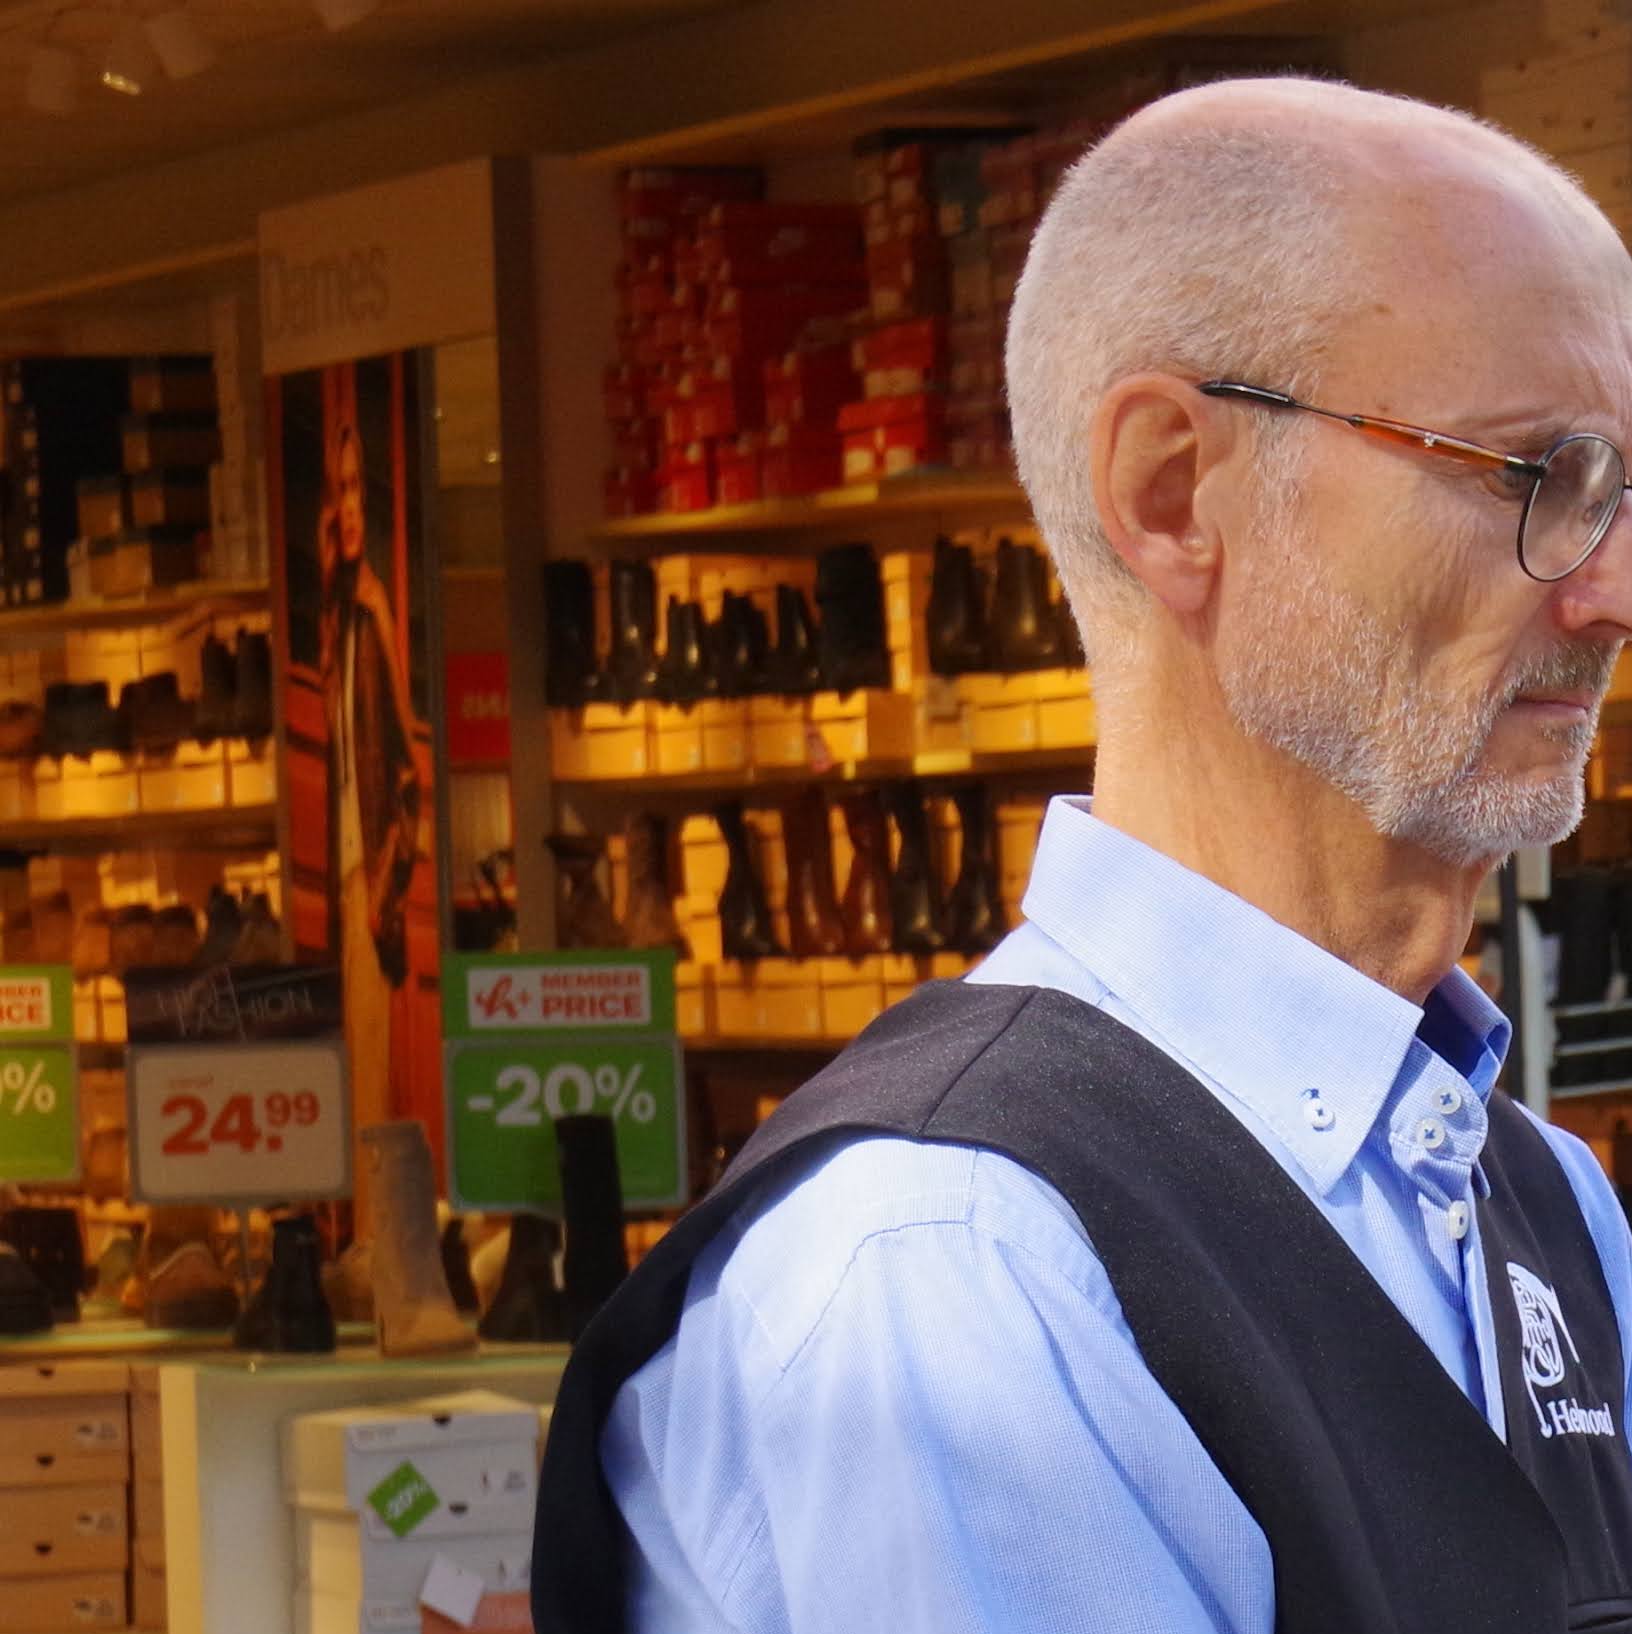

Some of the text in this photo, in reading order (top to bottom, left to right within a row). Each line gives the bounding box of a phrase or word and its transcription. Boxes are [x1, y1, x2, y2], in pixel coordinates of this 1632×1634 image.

[541, 970, 641, 989] MEMBER
[541, 993, 643, 1020] PRICE
[467, 1063, 656, 1126] -20%
[161, 1091, 320, 1156] 24.99
